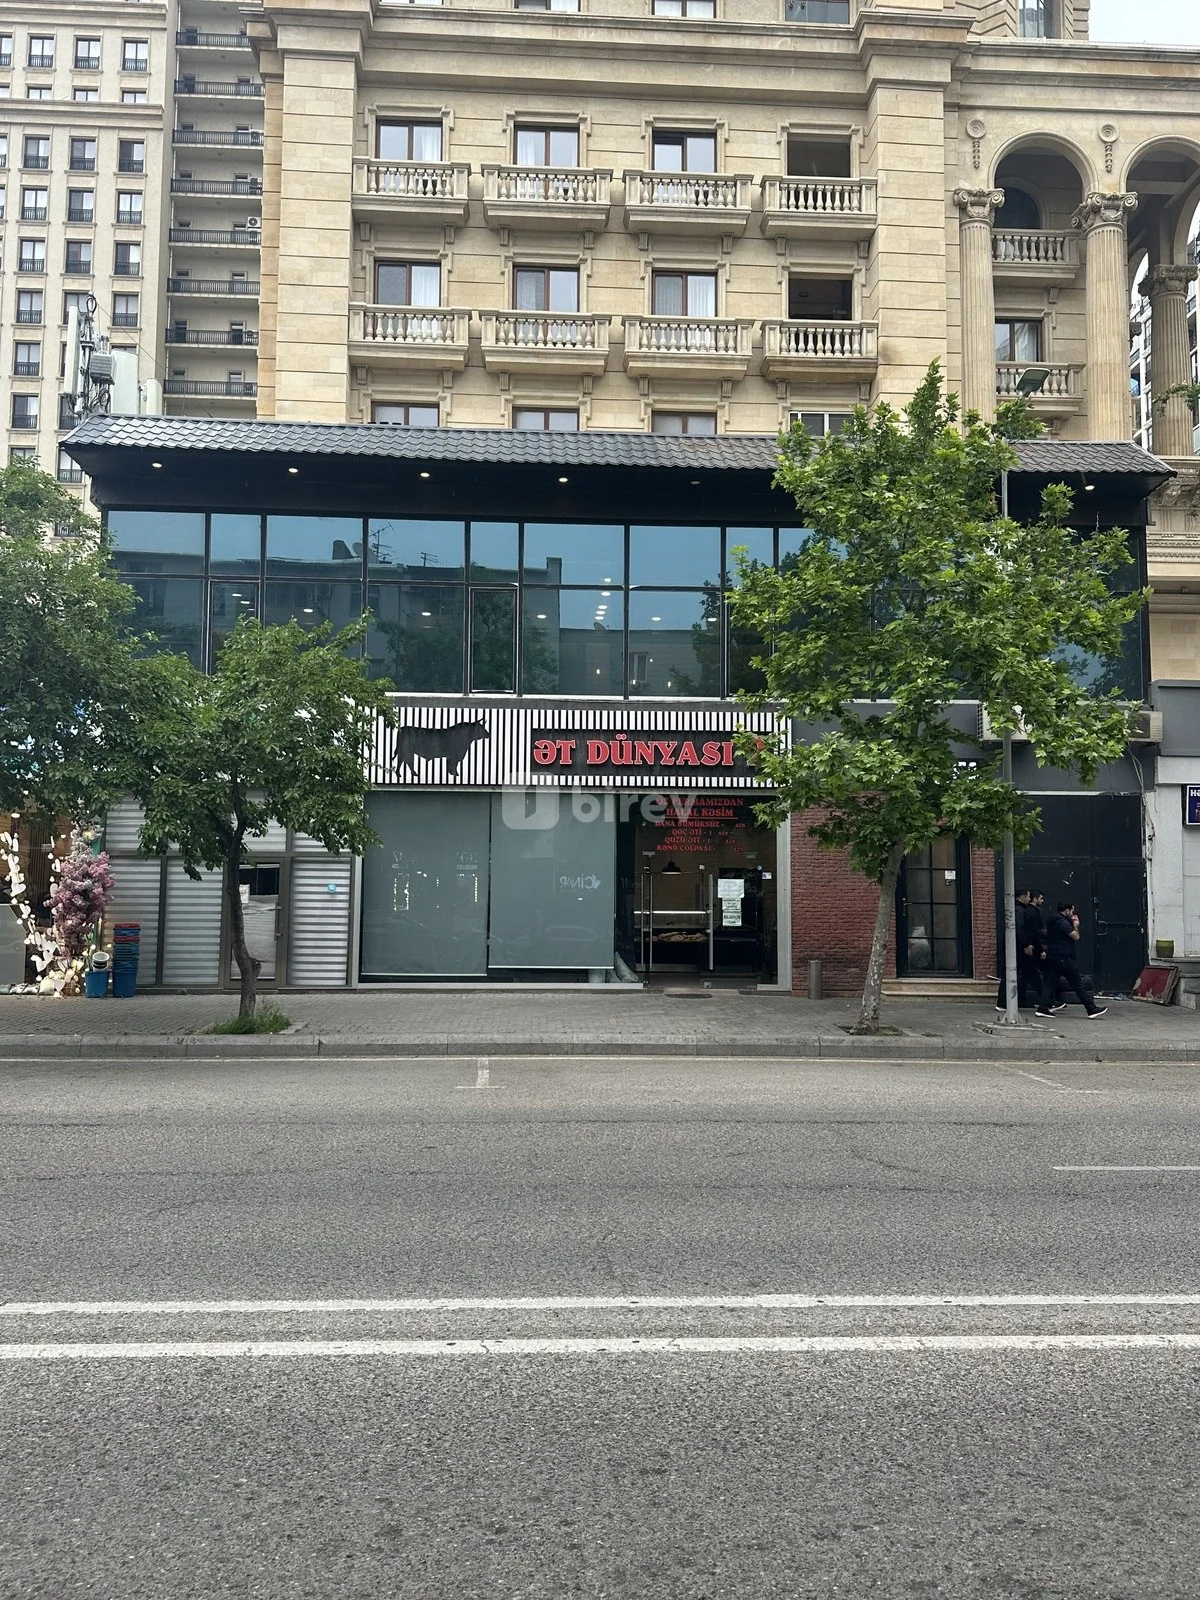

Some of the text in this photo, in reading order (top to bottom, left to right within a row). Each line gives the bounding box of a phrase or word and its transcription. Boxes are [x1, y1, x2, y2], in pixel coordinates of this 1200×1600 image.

[533, 739, 575, 765] ƏT
[587, 733, 734, 766] DÜNYASI
[666, 806, 734, 816] HALAL KƏSİM
